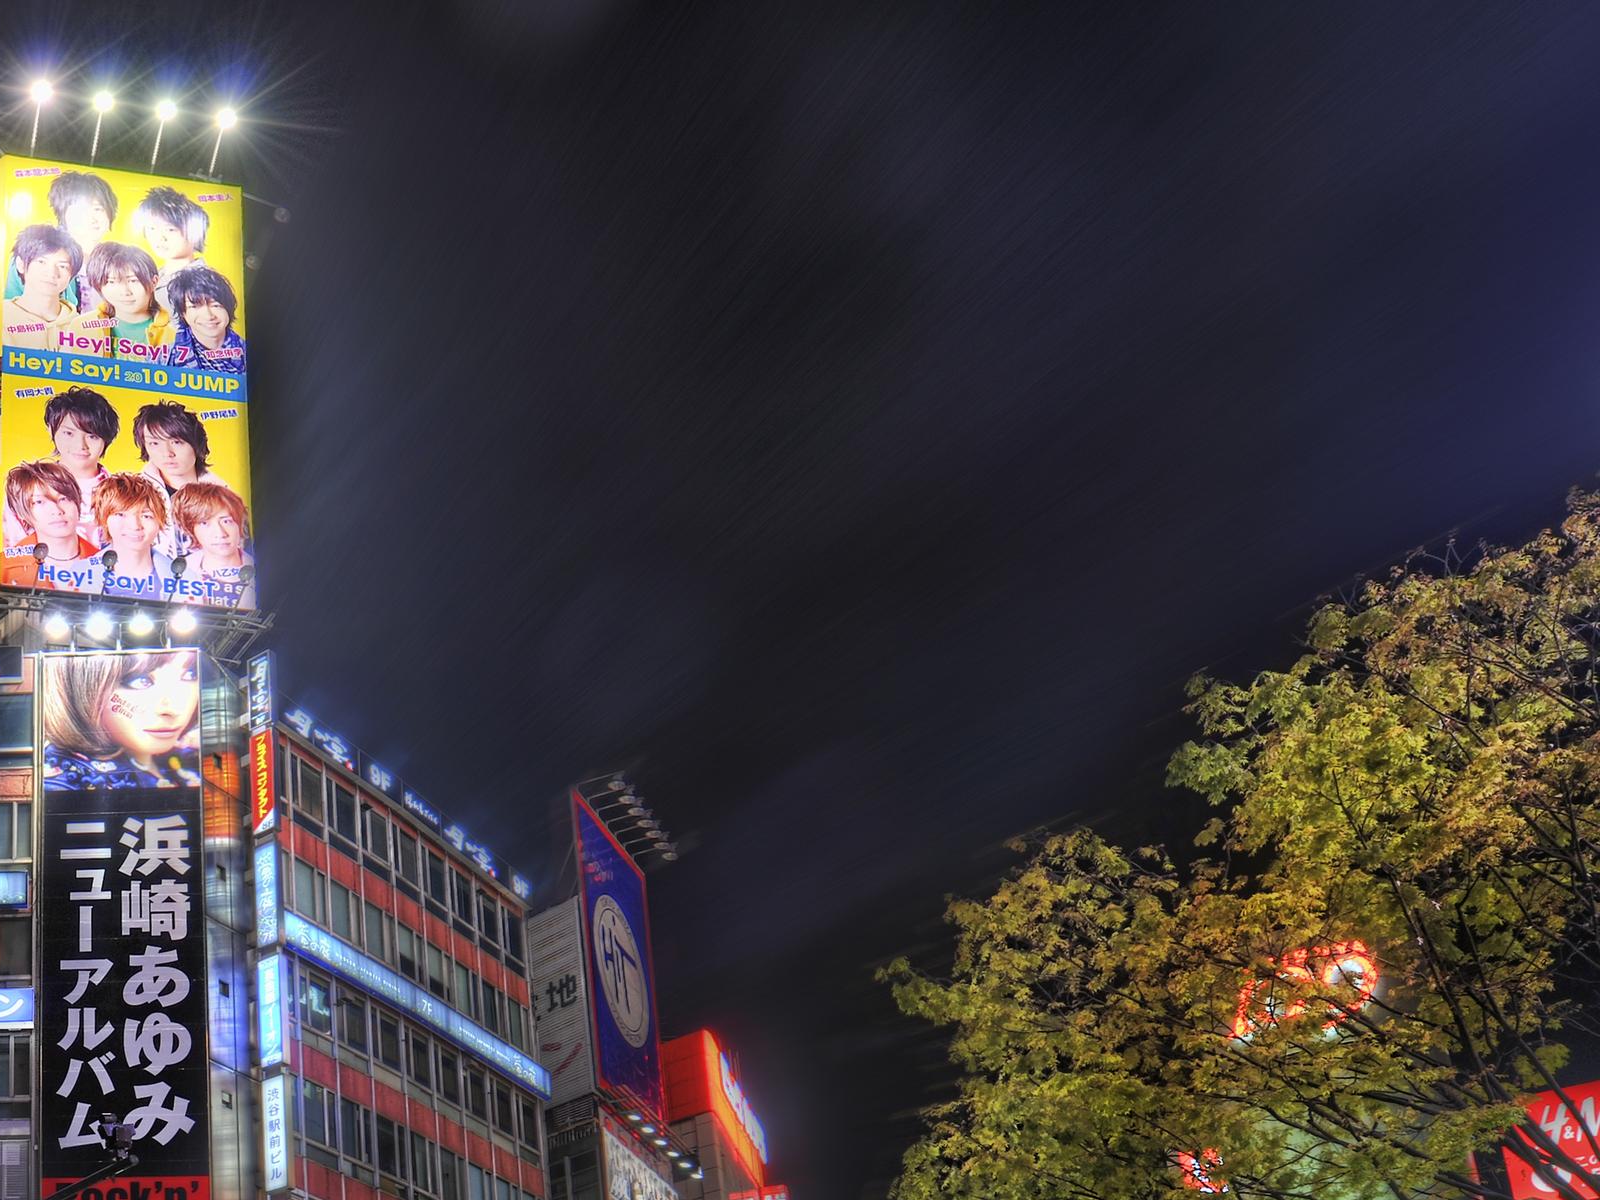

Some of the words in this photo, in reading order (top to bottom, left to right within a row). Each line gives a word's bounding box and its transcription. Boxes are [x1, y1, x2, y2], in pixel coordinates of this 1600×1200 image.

[59, 331, 112, 352] Hey!
[119, 338, 168, 359] Say!
[176, 346, 190, 362] 7
[9, 352, 62, 374] Hey!
[70, 359, 120, 385] Say!
[173, 373, 240, 394] JUMP
[38, 564, 93, 587] Hey!
[103, 570, 154, 594] Say!
[163, 577, 218, 597] BEST
[369, 764, 392, 791] 9F
[57, 821, 114, 1151] ニューアルバム
[118, 814, 195, 1146] 浜崎あゆみ
[421, 999, 434, 1015] 7F
[267, 1087, 283, 1182] 渋谷駅前ビル
